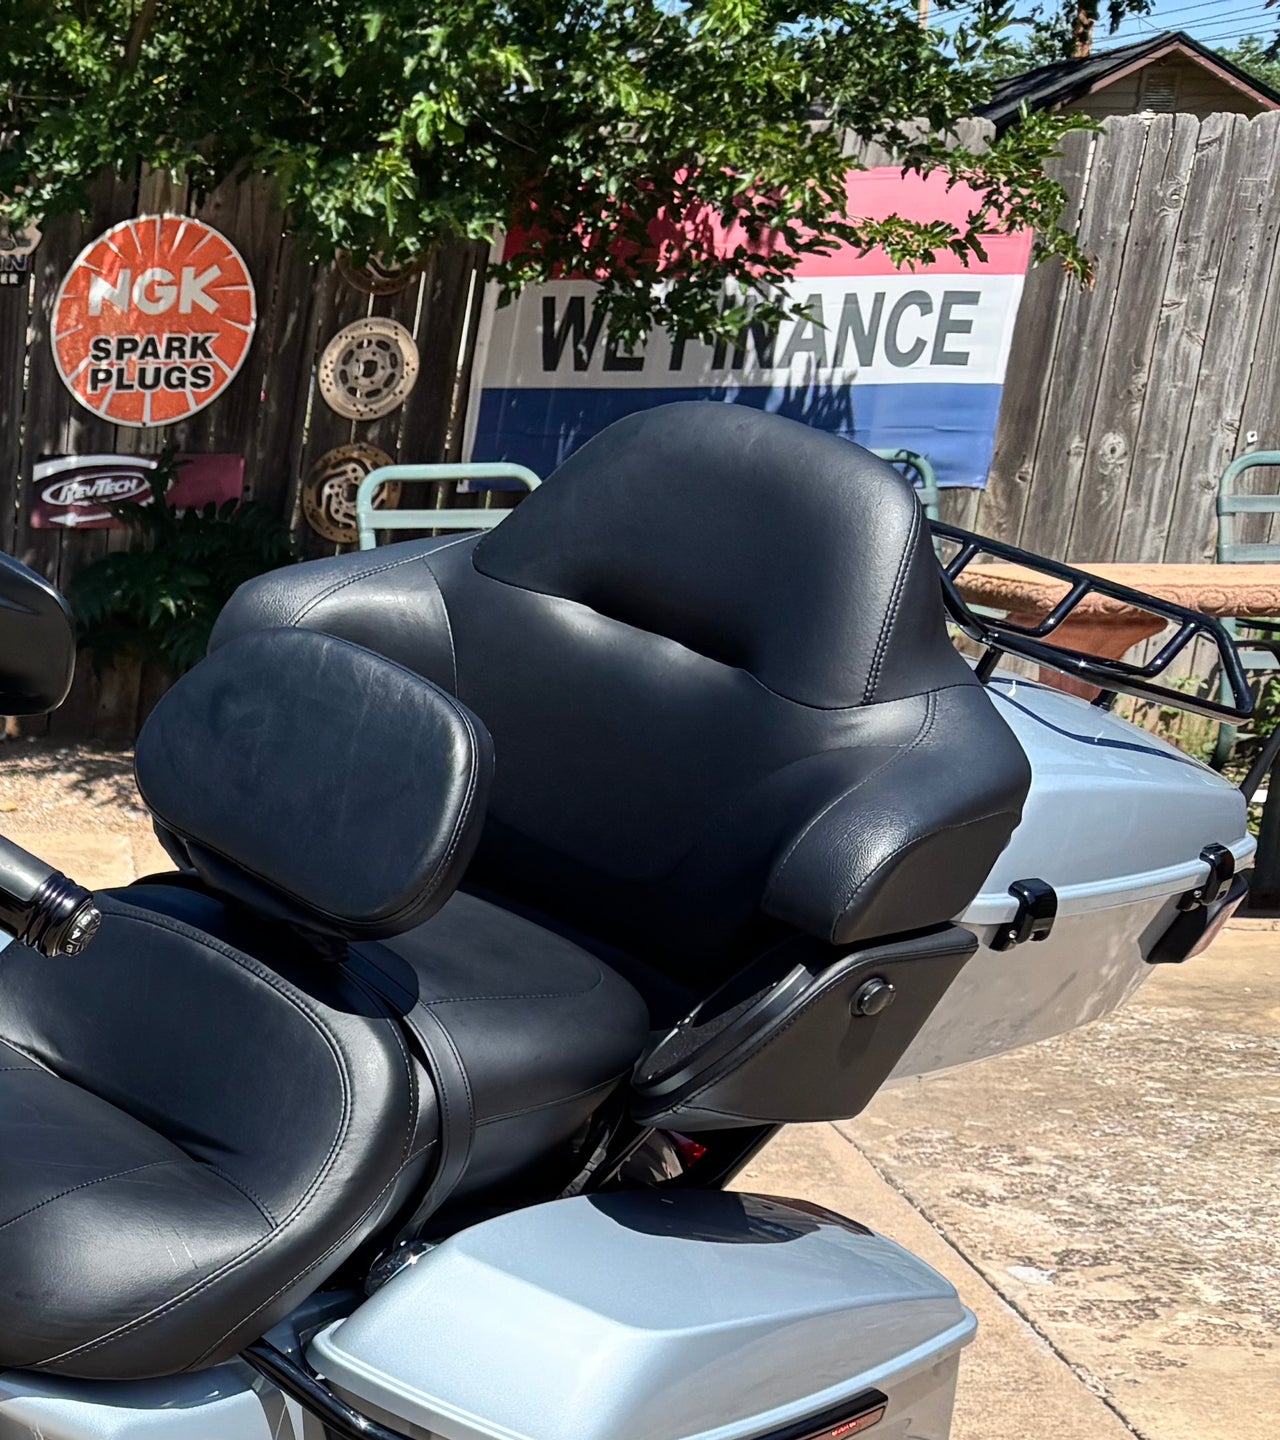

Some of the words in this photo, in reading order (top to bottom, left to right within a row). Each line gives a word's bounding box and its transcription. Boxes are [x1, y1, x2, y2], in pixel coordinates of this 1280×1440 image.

[88, 264, 223, 317] NGK
[90, 334, 216, 362] SPARK
[90, 364, 214, 392] PLUGS
